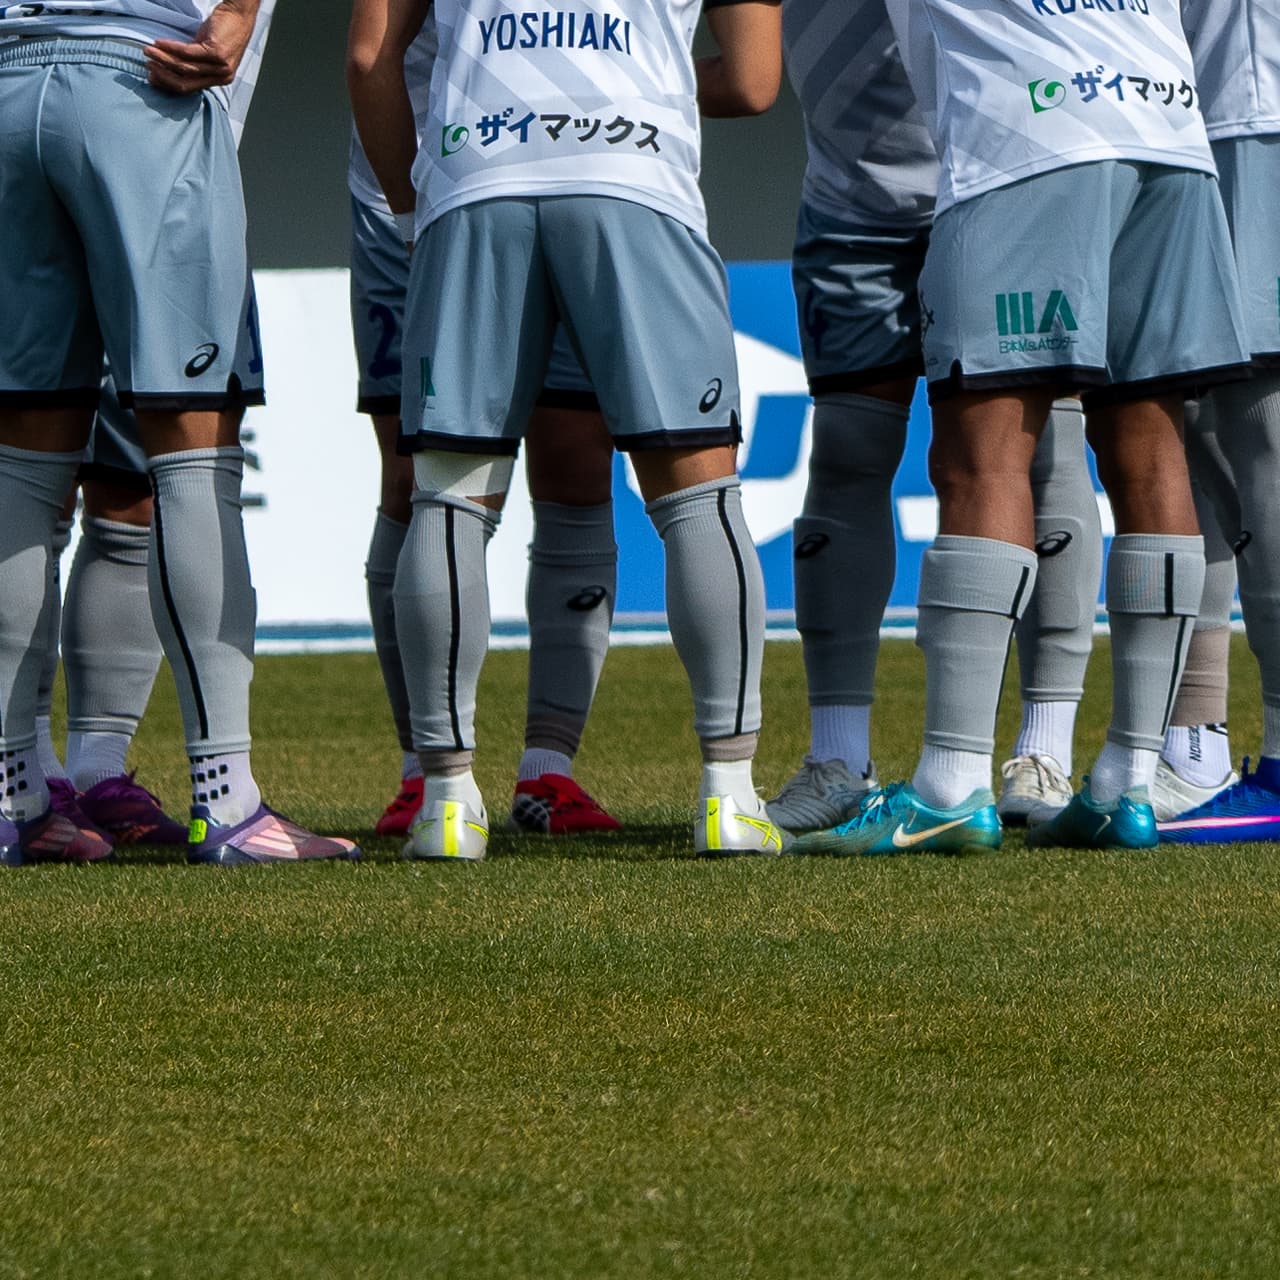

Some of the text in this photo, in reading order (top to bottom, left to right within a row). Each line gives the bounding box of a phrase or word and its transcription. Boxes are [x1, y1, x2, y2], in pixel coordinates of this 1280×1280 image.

[478, 11, 632, 55] YOSHIAKI
[1071, 65, 1203, 112] ザイマック
[476, 107, 661, 153] ザイマックス
